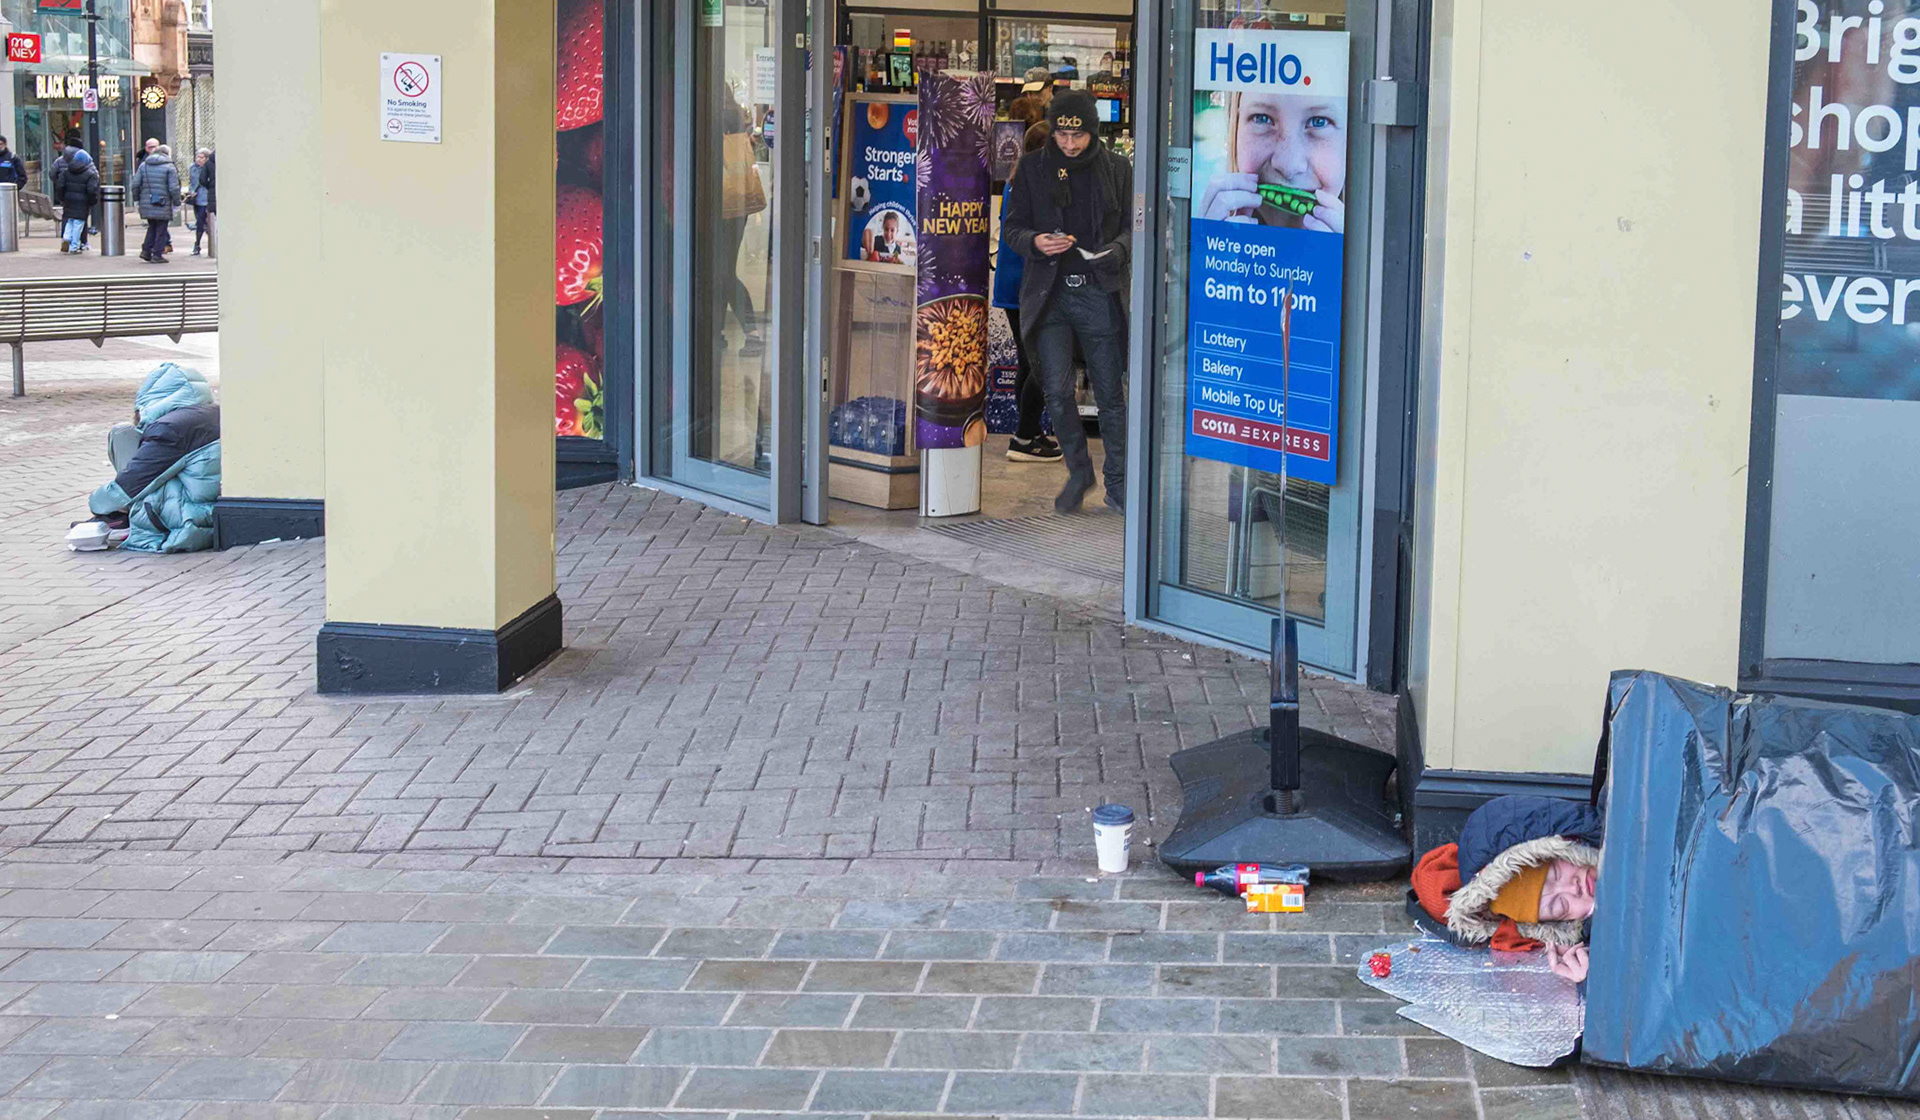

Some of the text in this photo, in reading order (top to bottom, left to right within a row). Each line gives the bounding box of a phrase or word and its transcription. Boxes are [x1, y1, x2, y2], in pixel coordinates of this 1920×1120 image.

[1210, 42, 1311, 86] Hello.
[36, 75, 120, 98] BLACK SHEE OFFEE
[398, 99, 427, 108] Smoking
[1057, 114, 1082, 127] dxb
[864, 146, 917, 168] Stronger
[886, 201, 906, 212] children
[940, 202, 983, 218] HAPPY
[923, 218, 961, 235] NEW
[1244, 243, 1276, 259] open
[1205, 255, 1313, 285] Monday to Sunday
[1204, 277, 1243, 302] 6am
[1247, 284, 1267, 305] to
[1203, 329, 1246, 353] Lottery
[1202, 357, 1243, 381] Bakery
[1202, 386, 1285, 417] Mobile Top Up
[1201, 418, 1320, 452] COSTA EXPRESS
